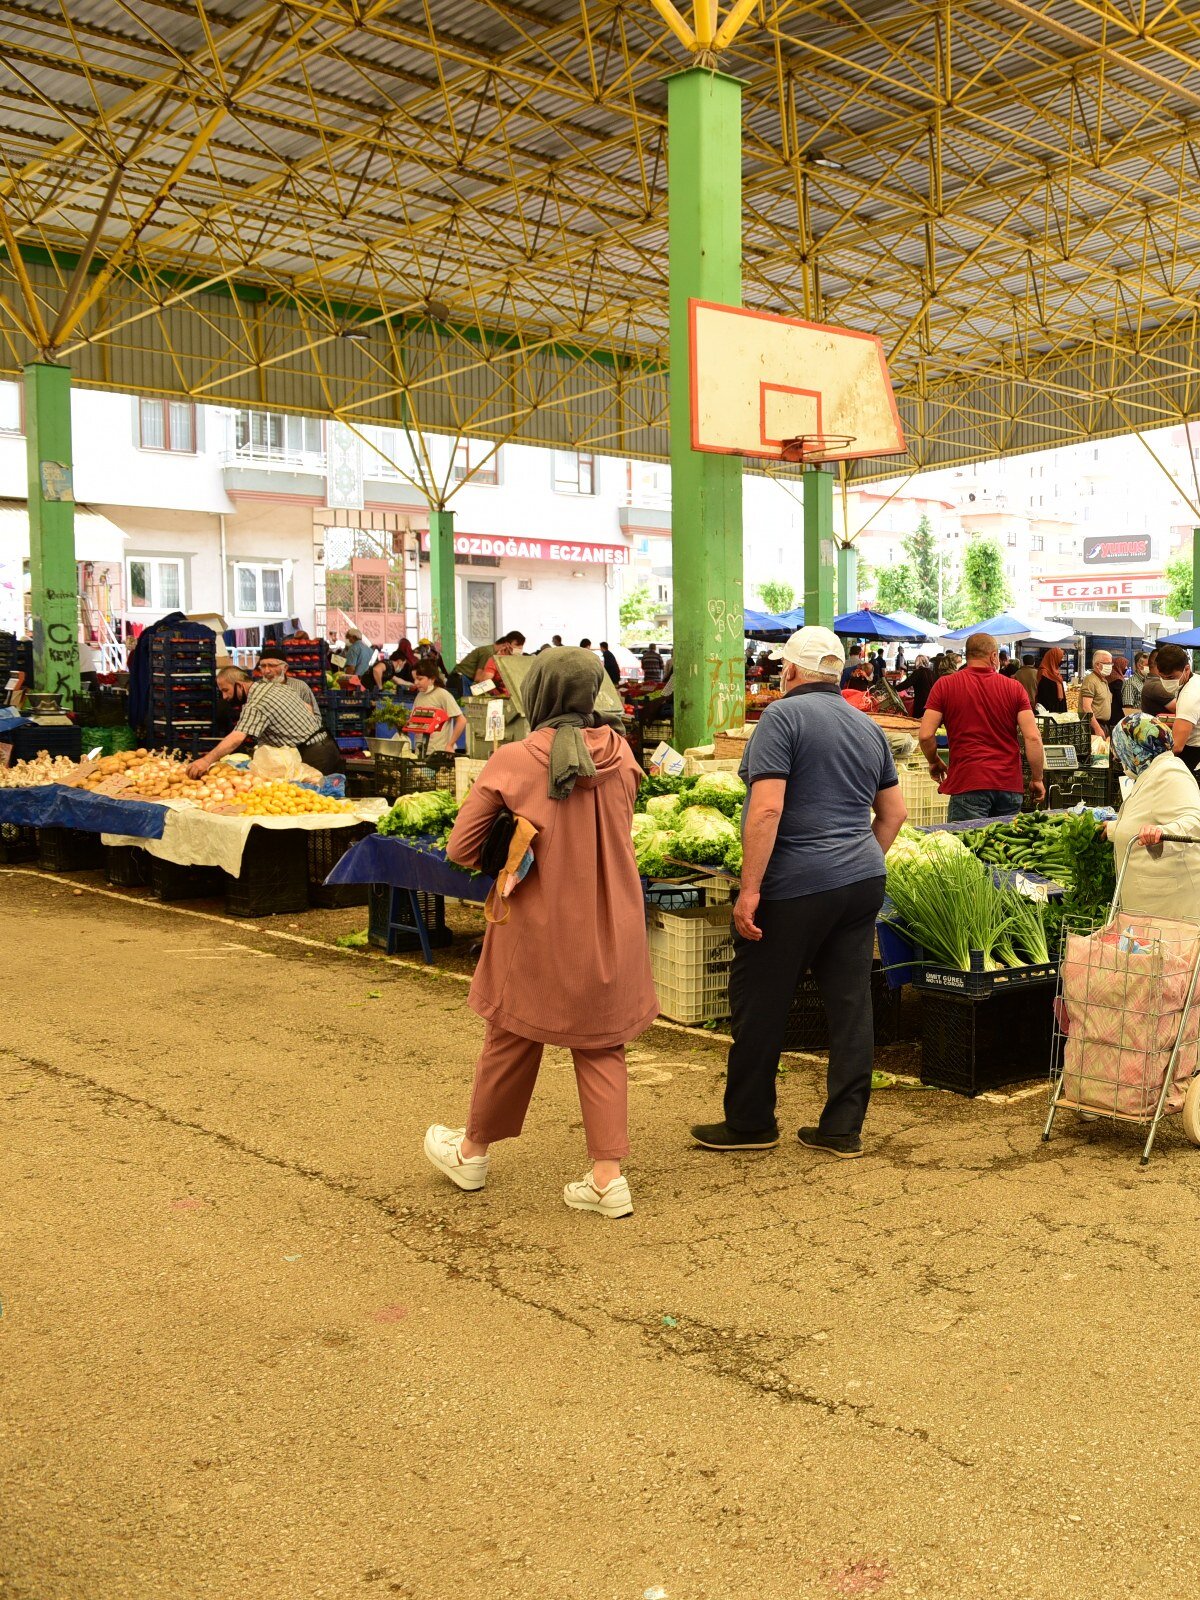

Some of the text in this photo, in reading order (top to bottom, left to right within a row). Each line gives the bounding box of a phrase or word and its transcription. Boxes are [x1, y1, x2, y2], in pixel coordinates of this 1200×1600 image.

[454, 538, 629, 565] OZDOĞAN ECZANESİ
[1100, 540, 1147, 558] yunus
